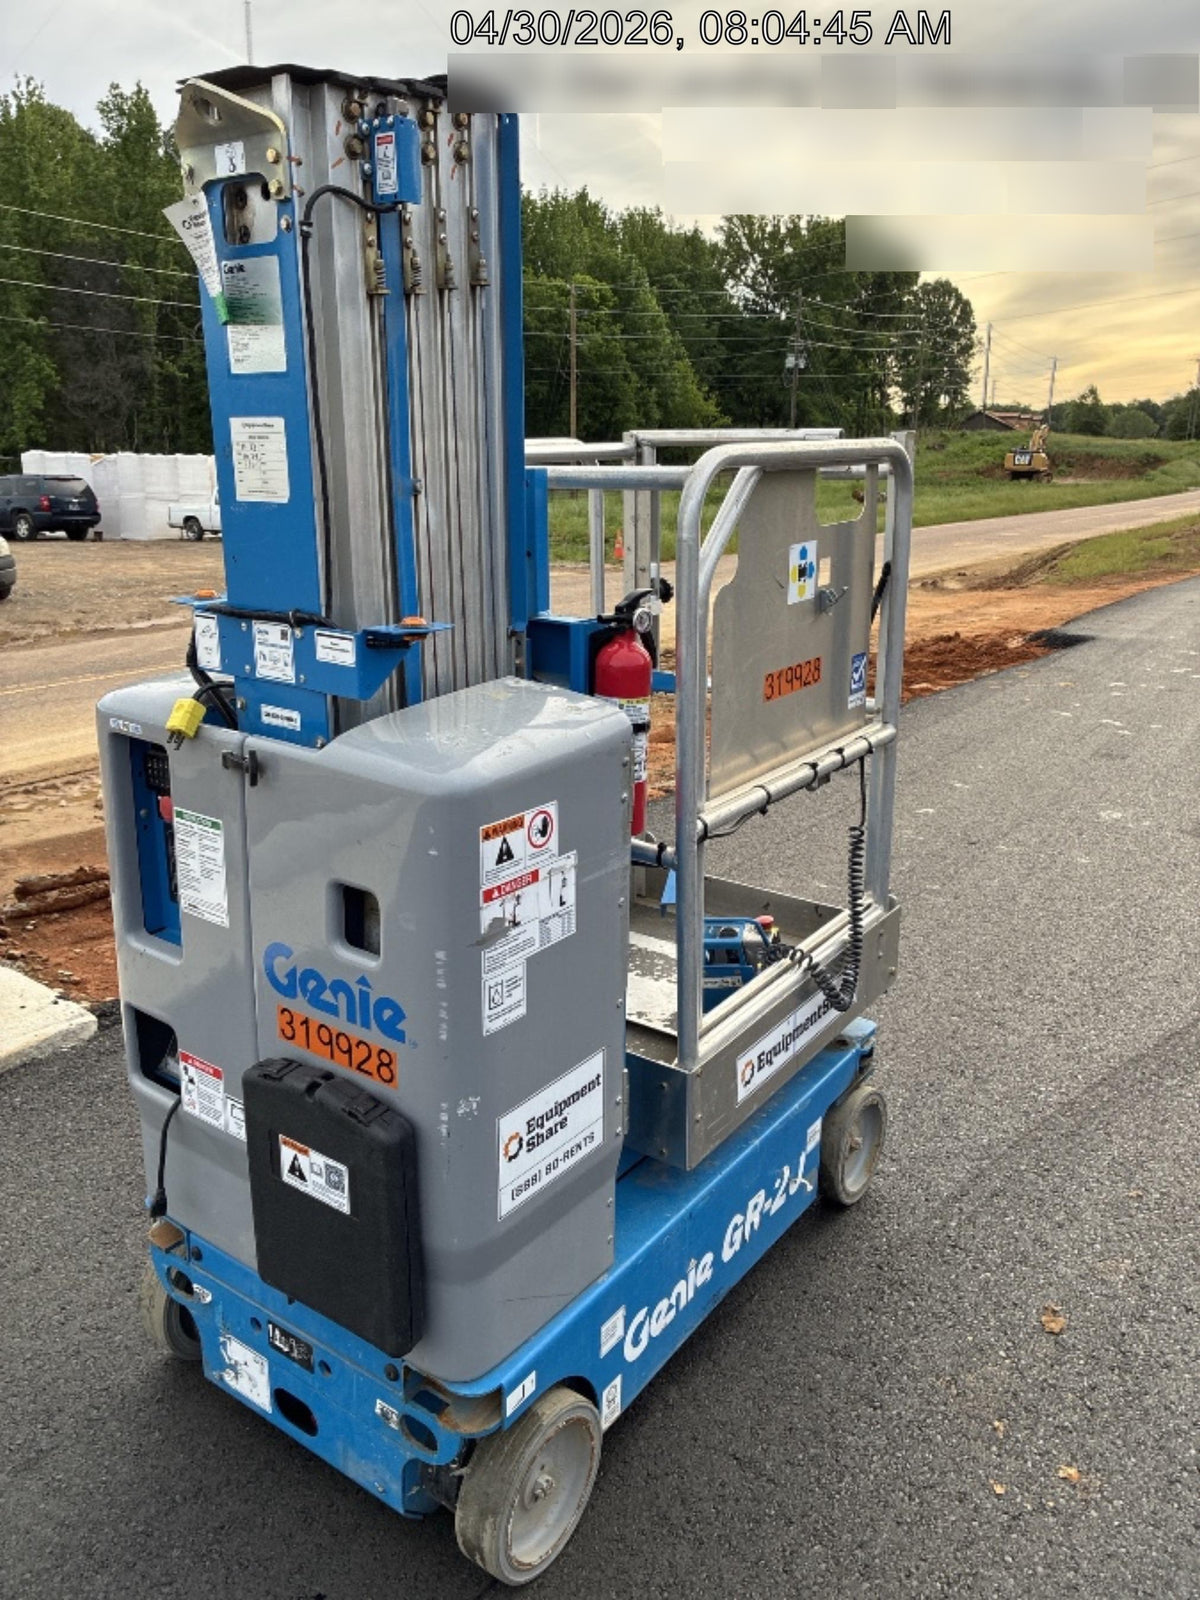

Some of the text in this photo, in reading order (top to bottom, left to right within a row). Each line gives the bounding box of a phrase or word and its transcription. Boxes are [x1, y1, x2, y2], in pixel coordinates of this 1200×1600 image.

[764, 656, 822, 700] 319928
[263, 941, 407, 1044] Genie
[279, 1007, 395, 1084] 319928
[525, 1072, 602, 1137] Equipment
[525, 1115, 569, 1154] Share
[624, 1251, 715, 1363] Genie
